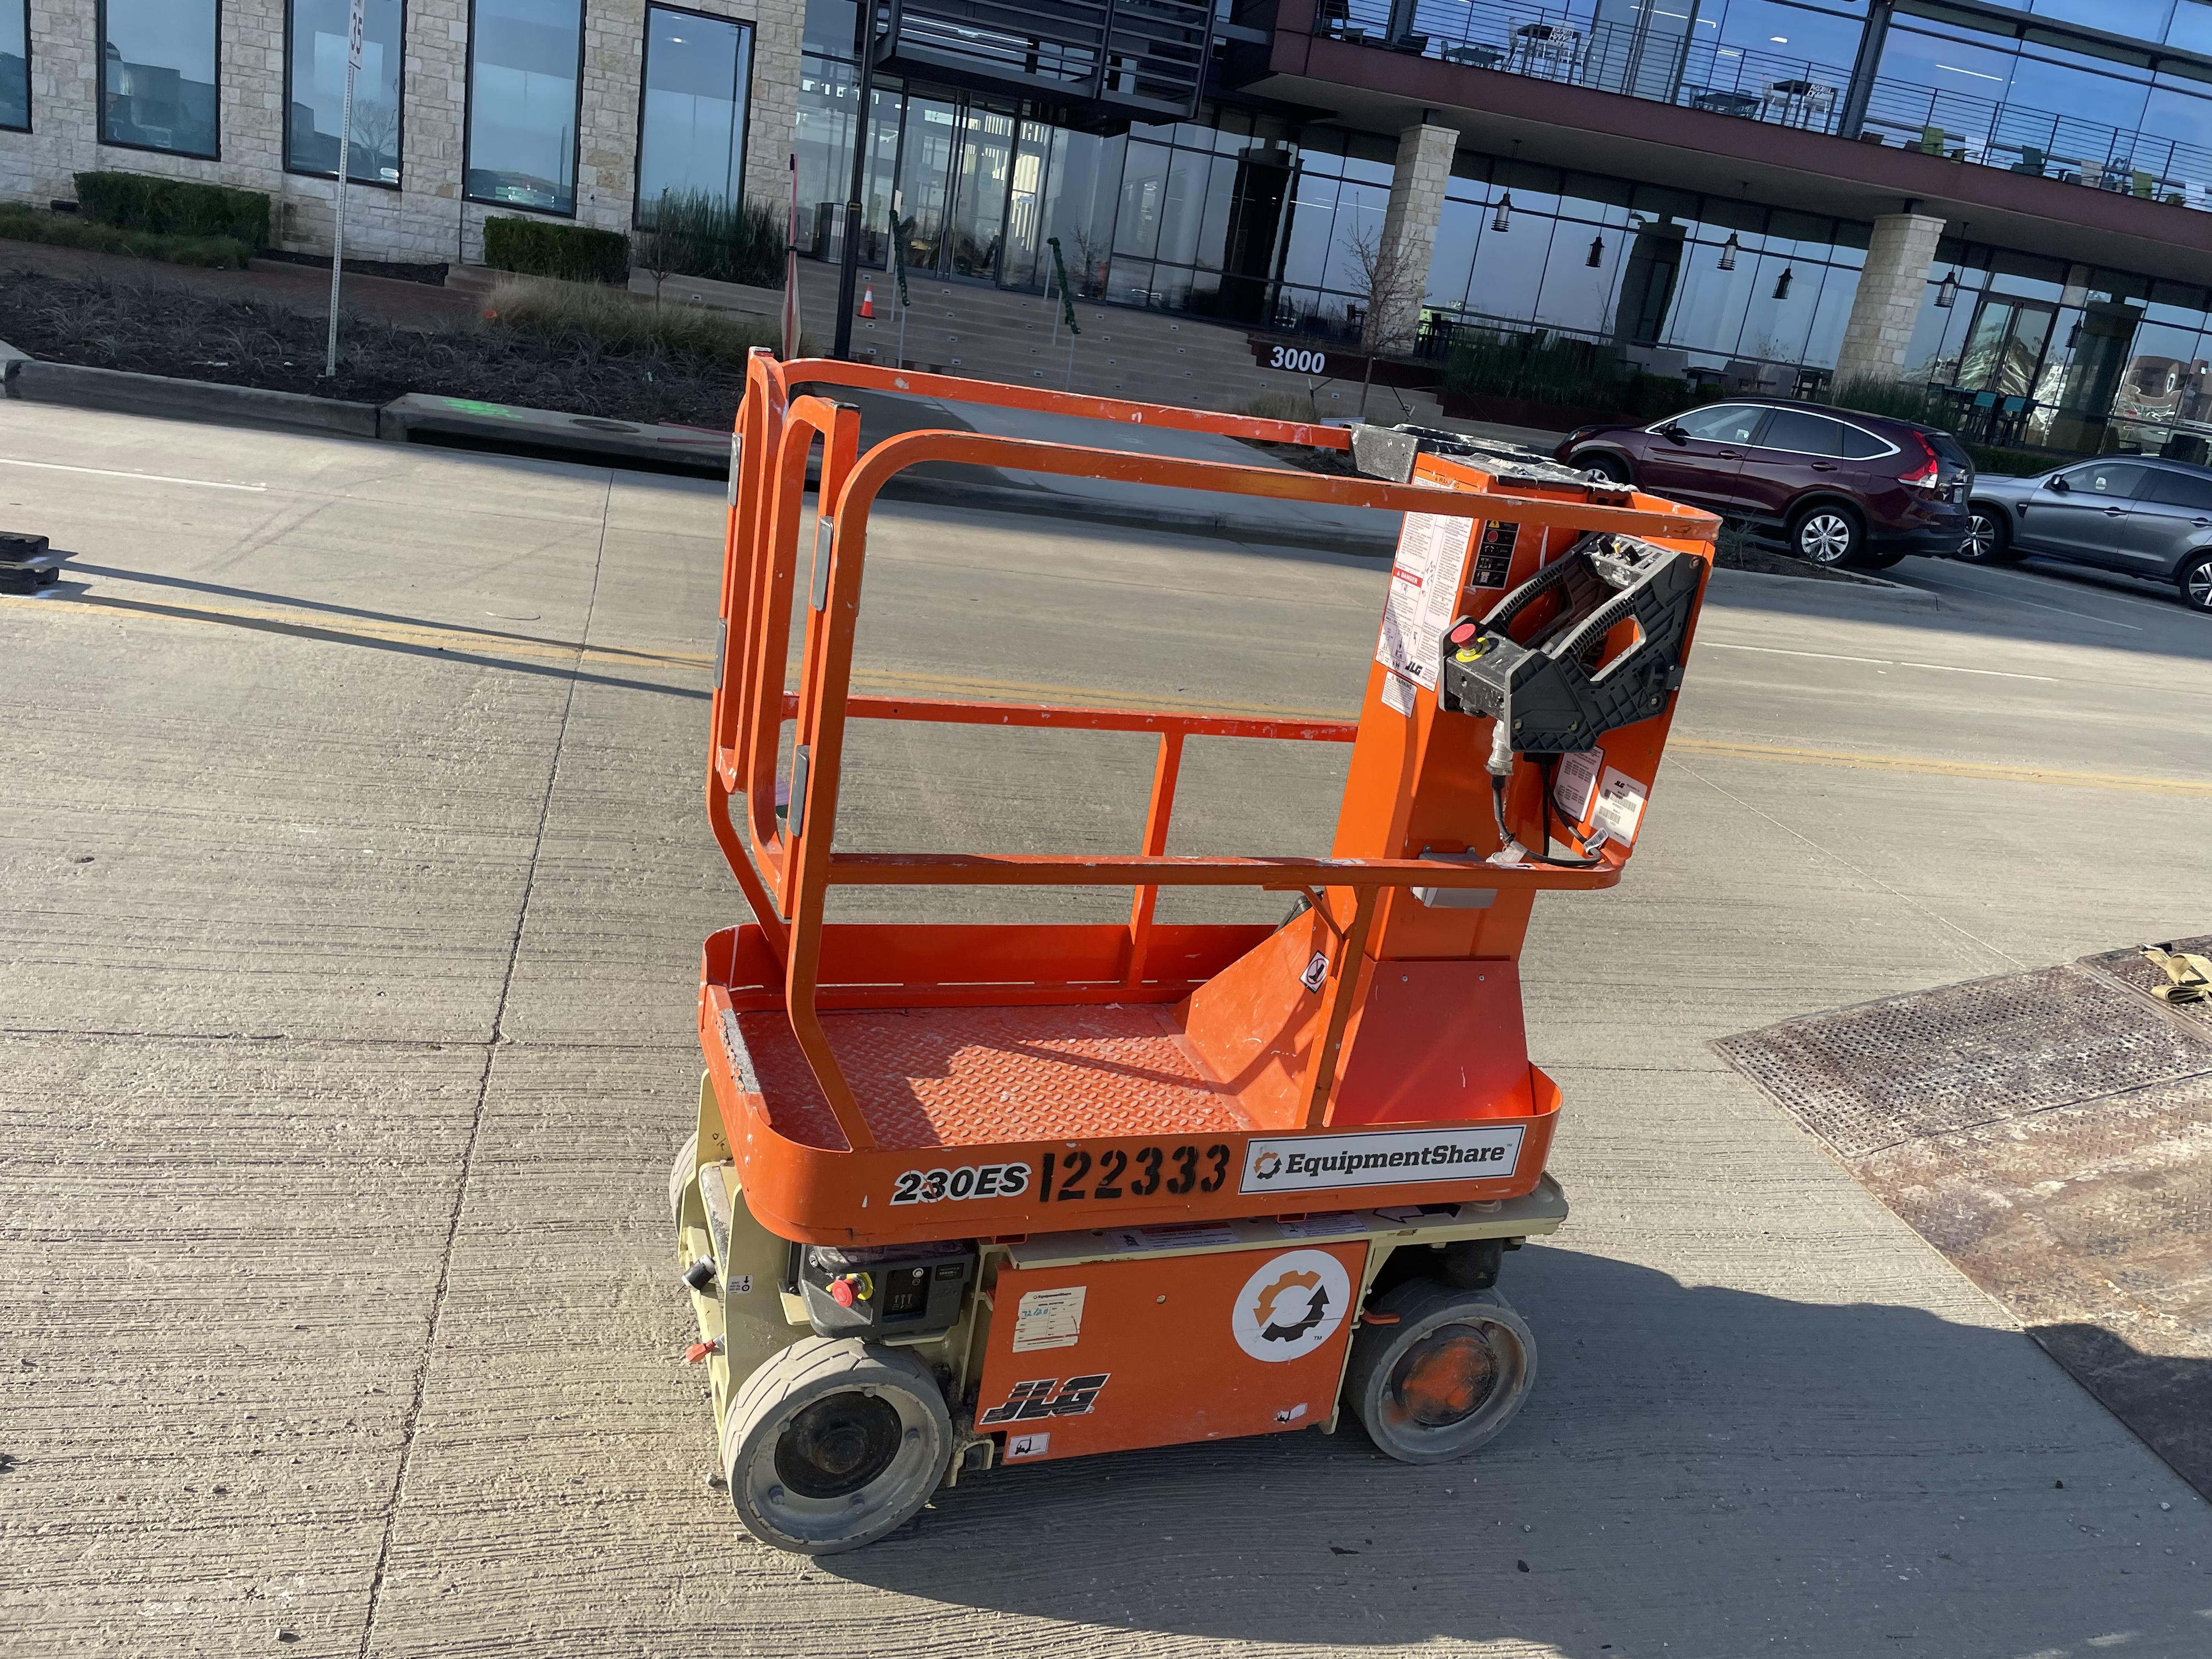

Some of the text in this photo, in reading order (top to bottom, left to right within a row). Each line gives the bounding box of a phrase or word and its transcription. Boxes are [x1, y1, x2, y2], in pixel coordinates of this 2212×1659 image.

[351, 12, 363, 54] 35
[1270, 346, 1325, 374] 3000
[1401, 572, 1418, 584] DANGER
[1404, 661, 1423, 676] JLG
[1614, 780, 1626, 789] JLG
[1039, 1144, 1231, 1203] 122333
[1285, 1144, 1505, 1178] EquipmentShare
[891, 1163, 1032, 1205] 230ES
[979, 1373, 1111, 1425] JLG
